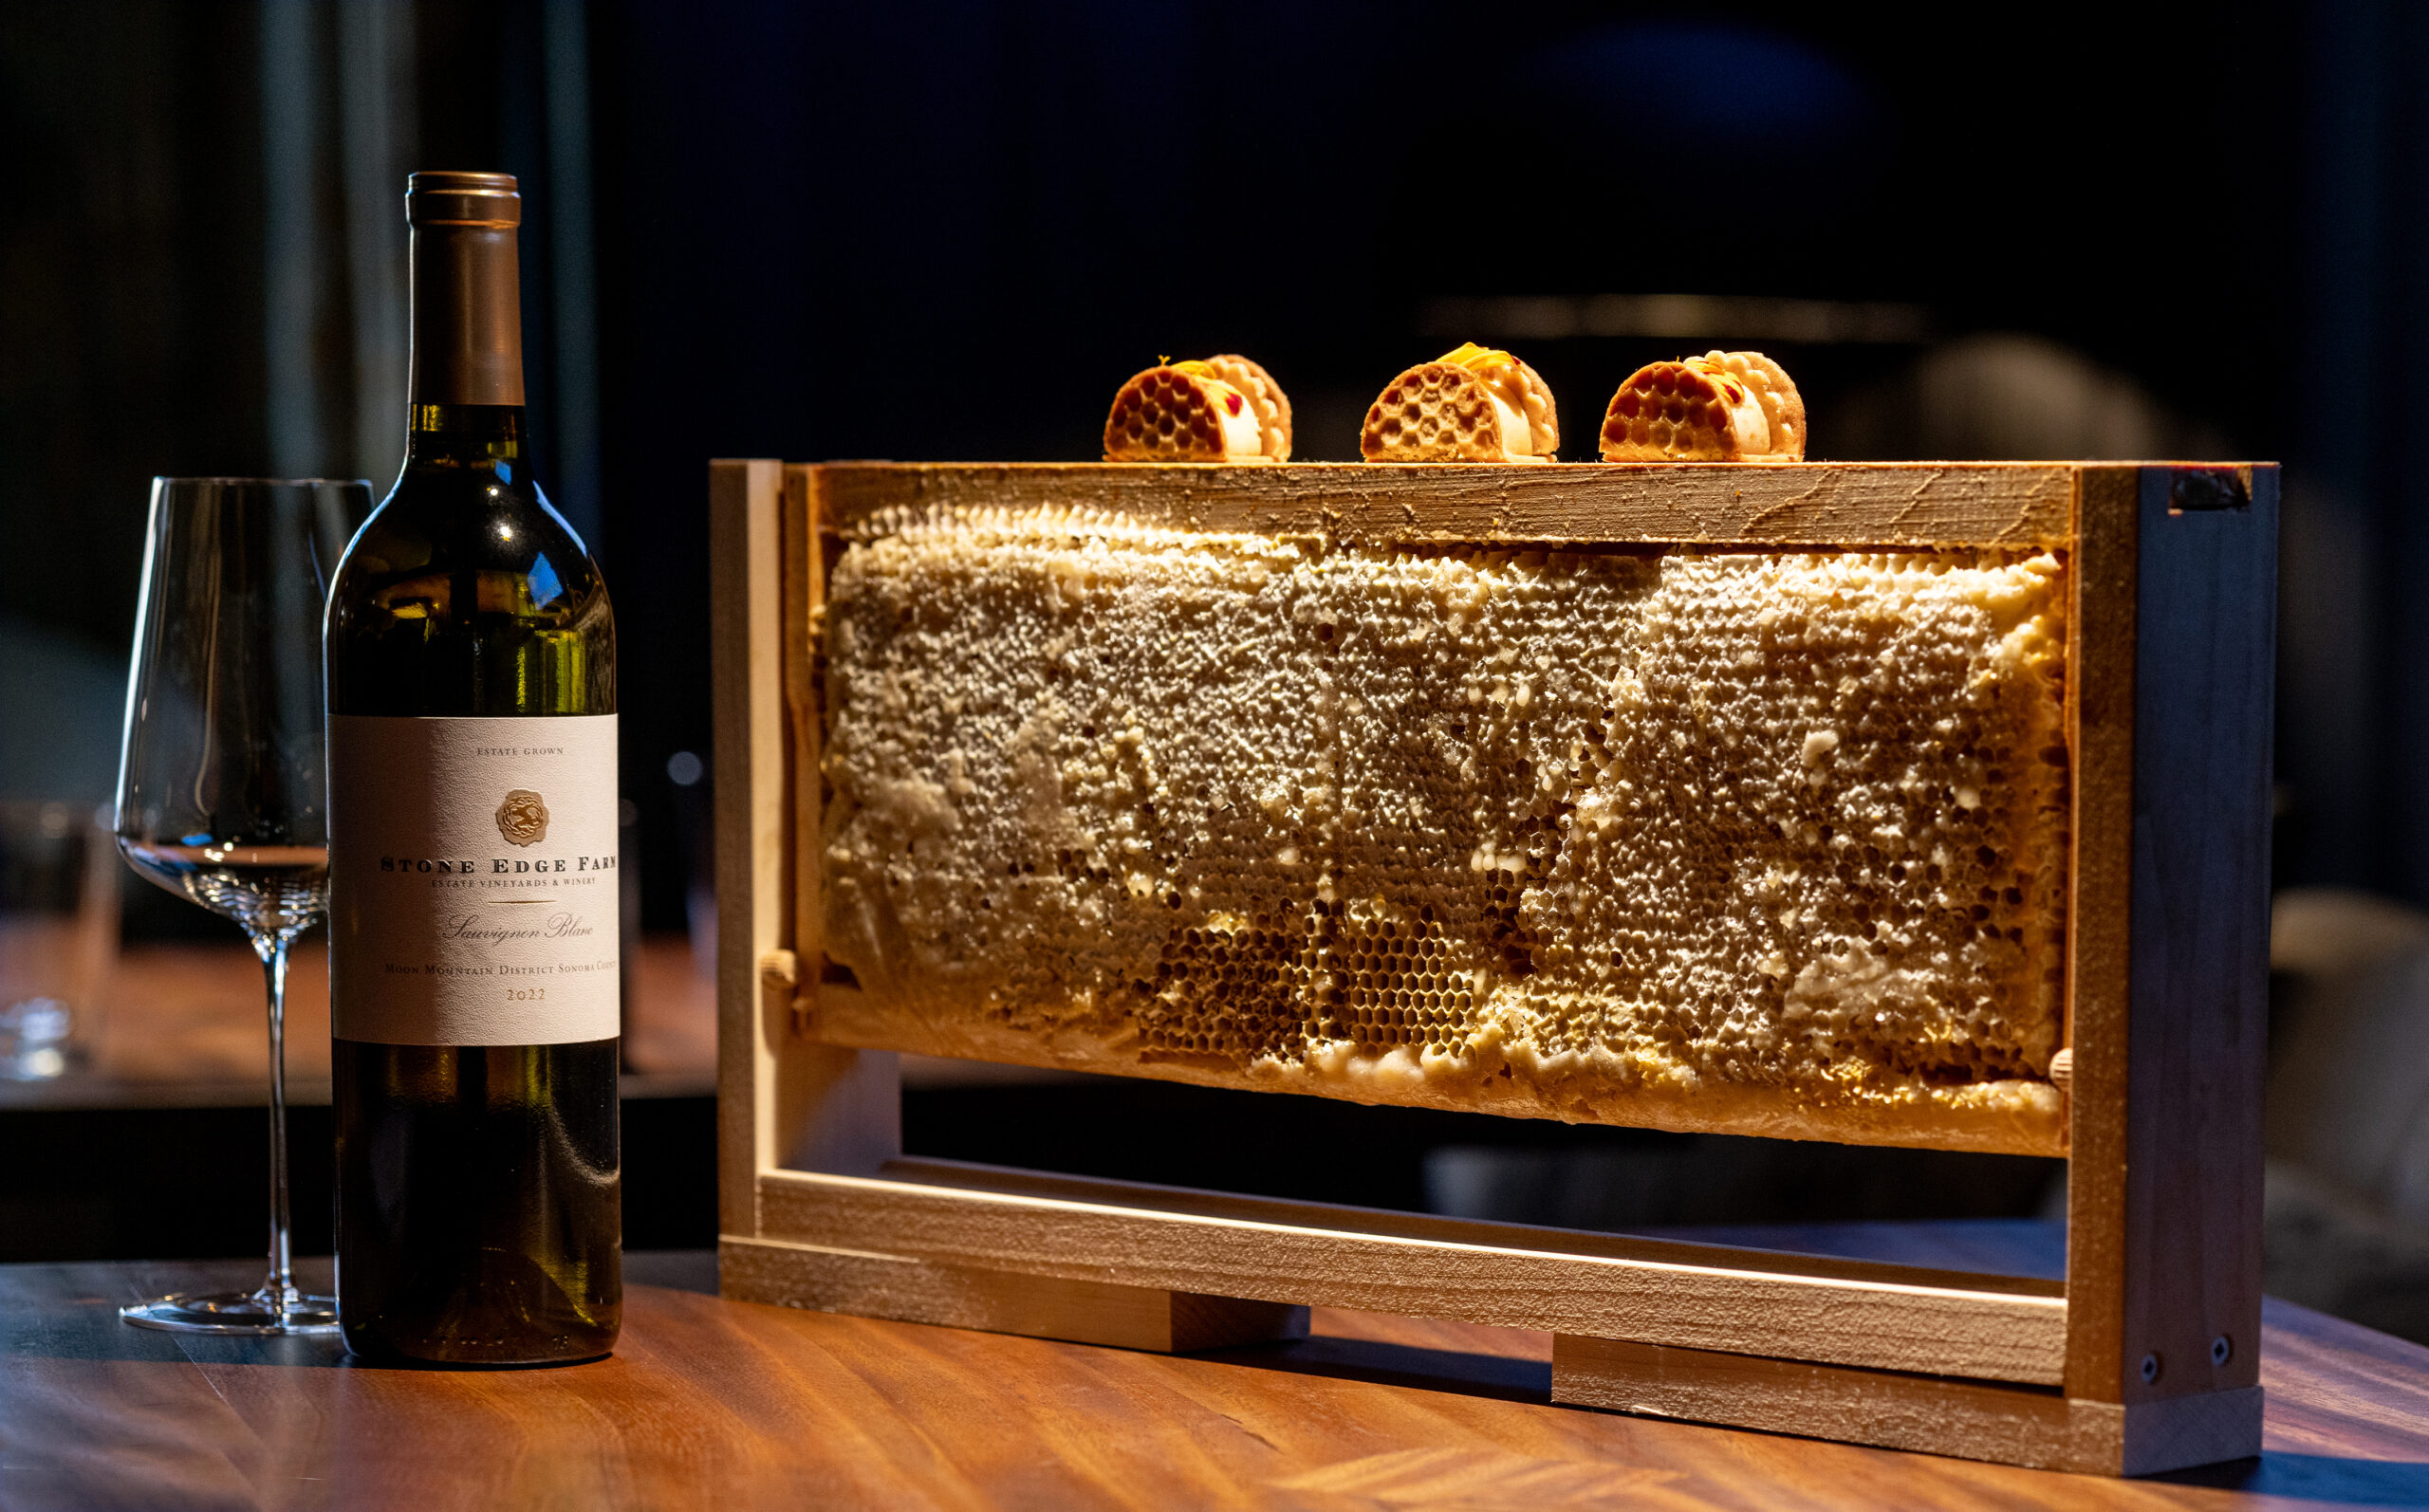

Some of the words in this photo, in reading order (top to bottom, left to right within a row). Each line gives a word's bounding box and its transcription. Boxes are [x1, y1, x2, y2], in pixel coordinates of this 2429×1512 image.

[476, 747, 519, 757] ESTATE
[522, 746, 565, 756] GROWN
[380, 856, 475, 874] STONE
[491, 857, 566, 874] EDGE
[577, 855, 617, 872] FARM
[432, 879, 474, 889] ESTATE
[479, 878, 548, 889] VINEYARDS
[551, 879, 559, 888] &
[562, 876, 597, 887] WINERY
[441, 913, 541, 948] Sauvignon
[543, 911, 594, 939] Blanc
[384, 963, 419, 975] MOON
[424, 964, 494, 976] MOUNTAIN
[498, 964, 555, 976] DISTRICT
[557, 962, 596, 974] SONOMA
[506, 987, 547, 1002] 2022
